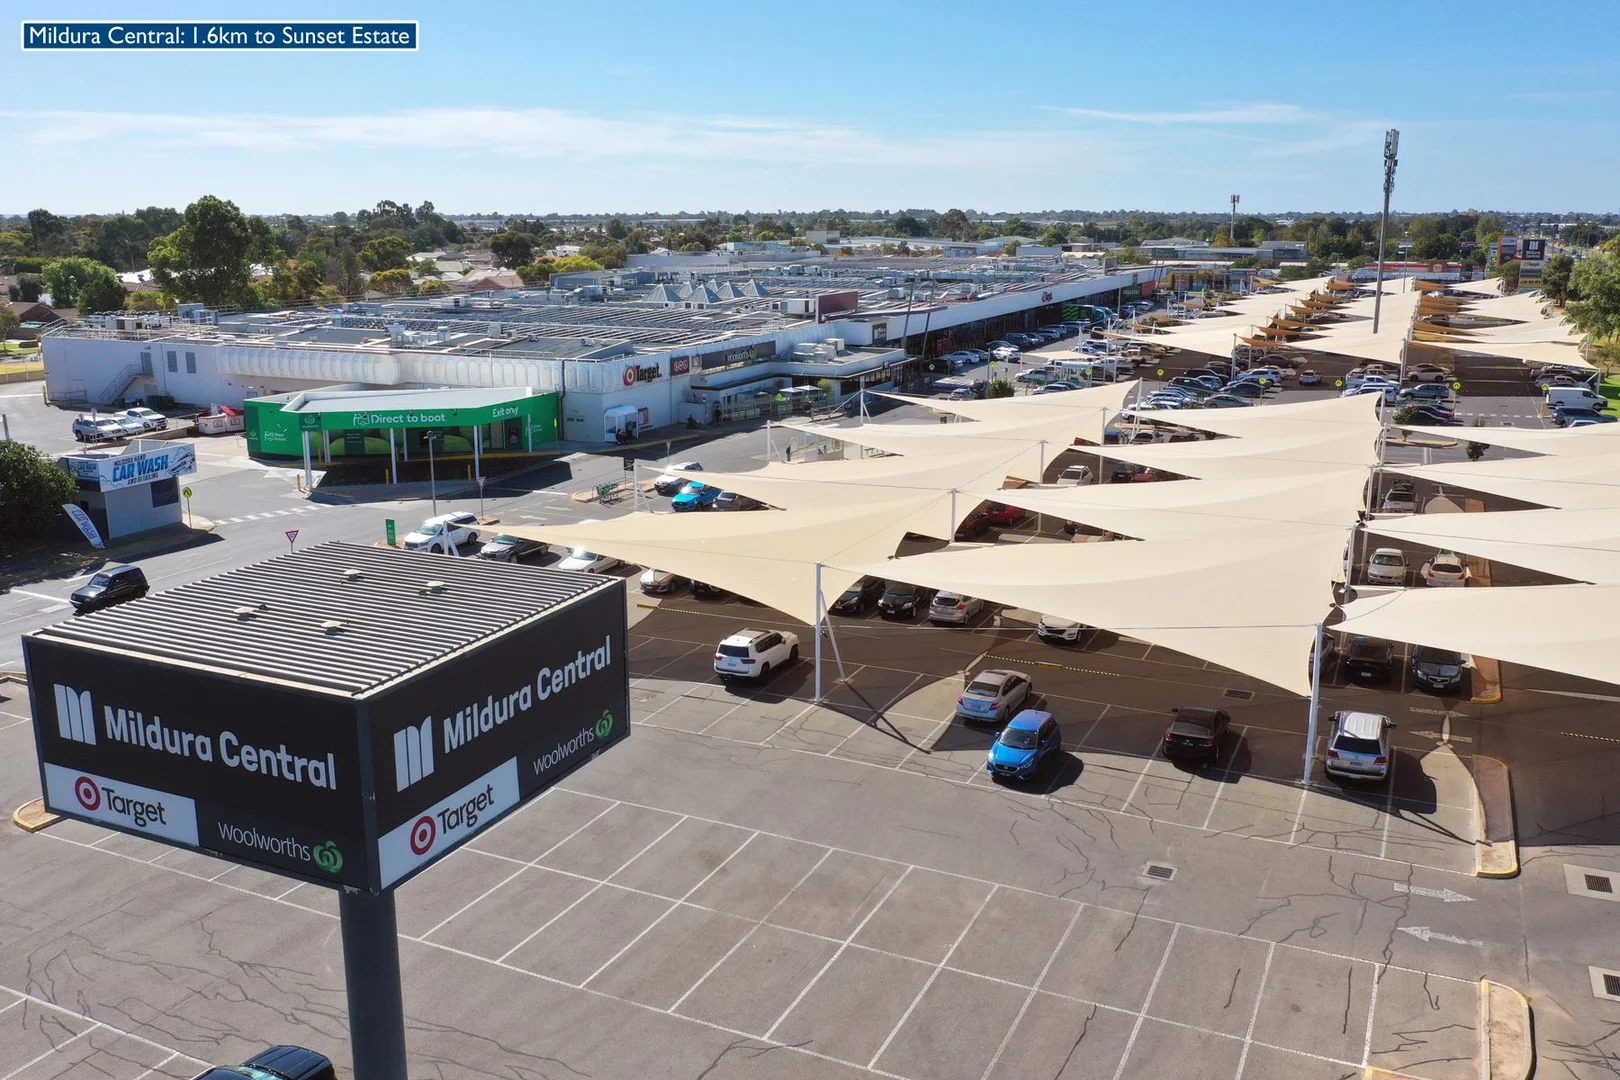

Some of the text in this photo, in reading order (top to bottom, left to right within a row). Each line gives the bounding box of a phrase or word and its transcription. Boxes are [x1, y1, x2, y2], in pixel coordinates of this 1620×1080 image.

[371, 413, 446, 424] Direct to boot
[492, 407, 519, 418] Exit only
[113, 454, 169, 482] CAR WASH
[443, 634, 611, 754] Mildura Central
[103, 705, 337, 790] Mildura Central
[533, 725, 595, 776] Woolworths
[101, 787, 167, 828] Target
[437, 784, 495, 835] Target
[217, 821, 311, 862] Woolworths
